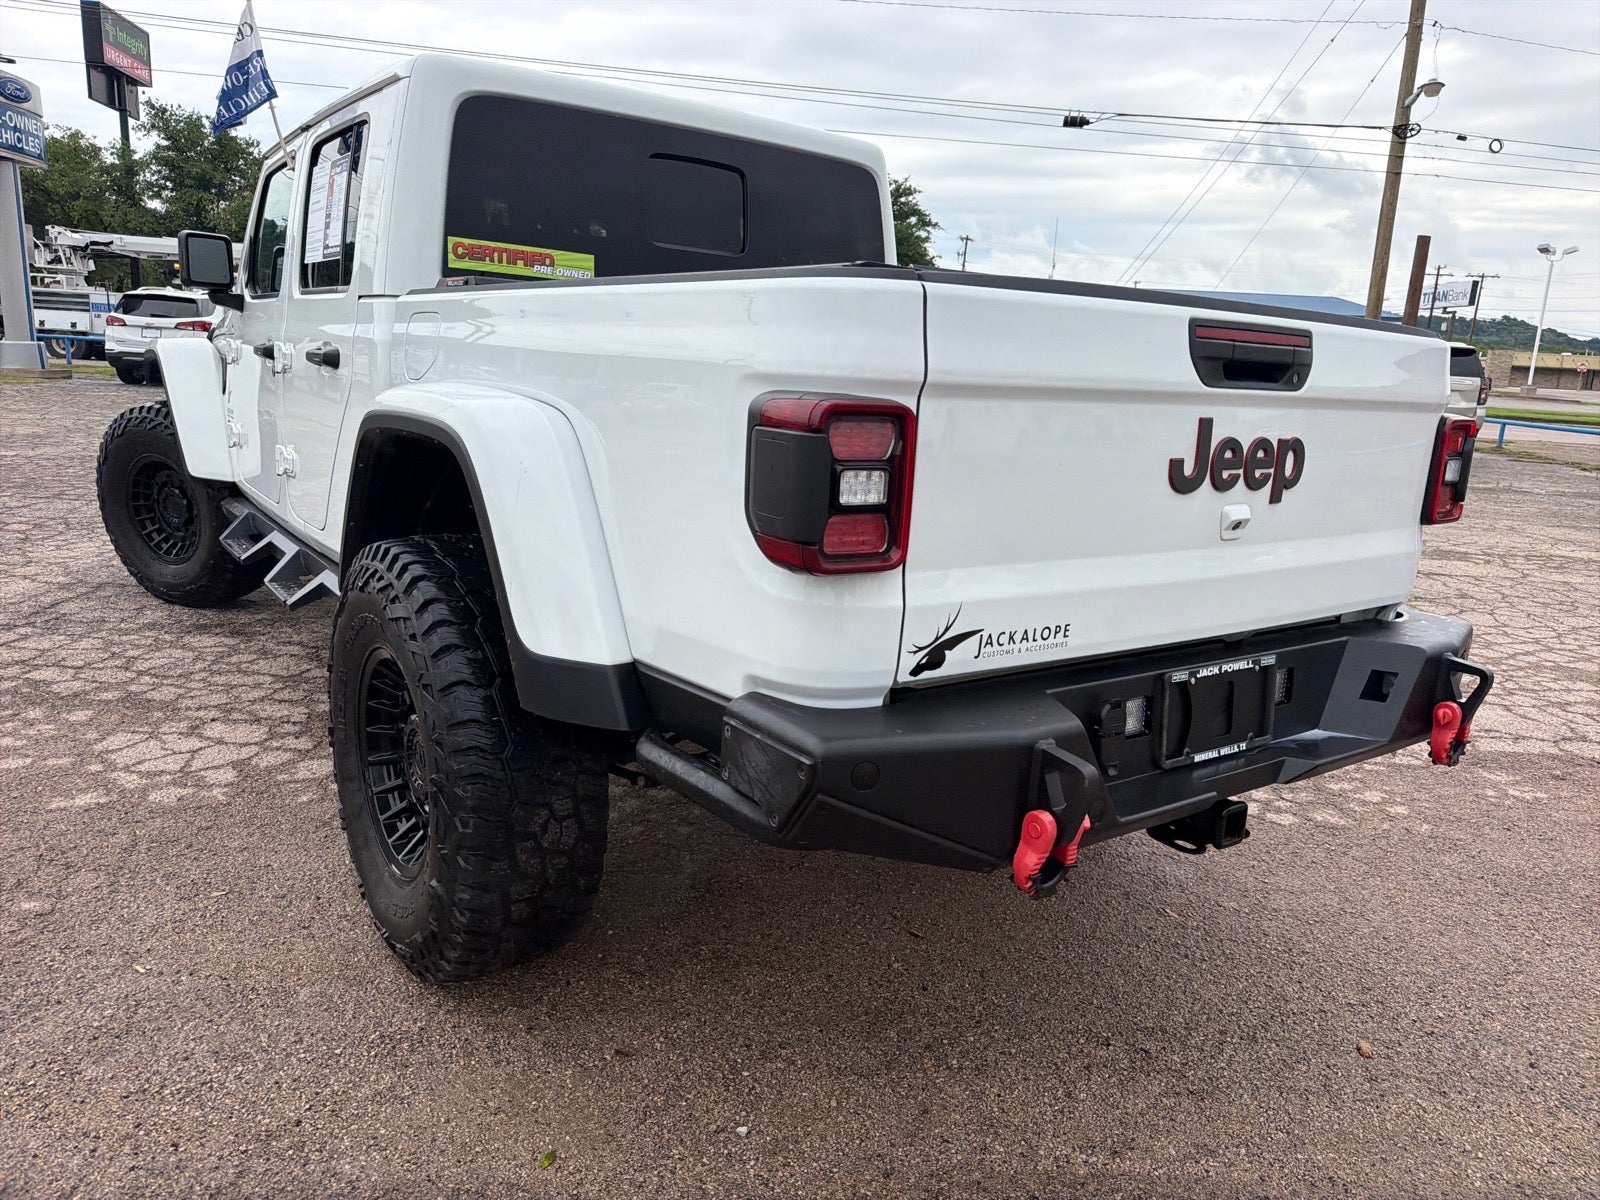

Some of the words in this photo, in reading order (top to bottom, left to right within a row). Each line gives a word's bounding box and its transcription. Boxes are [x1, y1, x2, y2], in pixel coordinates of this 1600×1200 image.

[116, 25, 148, 60] Integrity
[106, 46, 131, 68] URGENT
[133, 62, 149, 80] CARE
[5, 82, 26, 98] Ford
[0, 110, 43, 137] -OWNED
[452, 241, 556, 269] CERTIFIED
[534, 264, 591, 280] PRE-OWNED
[1168, 417, 1306, 504] Jeep
[974, 623, 1071, 659] JACKALOPE
[982, 648, 1015, 659] CUSTOMS
[1025, 640, 1069, 653] ACCESSORIES
[1196, 665, 1220, 678] JACK
[1221, 659, 1254, 673] POWELL
[1194, 750, 1219, 762] MINERAL
[1240, 742, 1247, 750] TX
